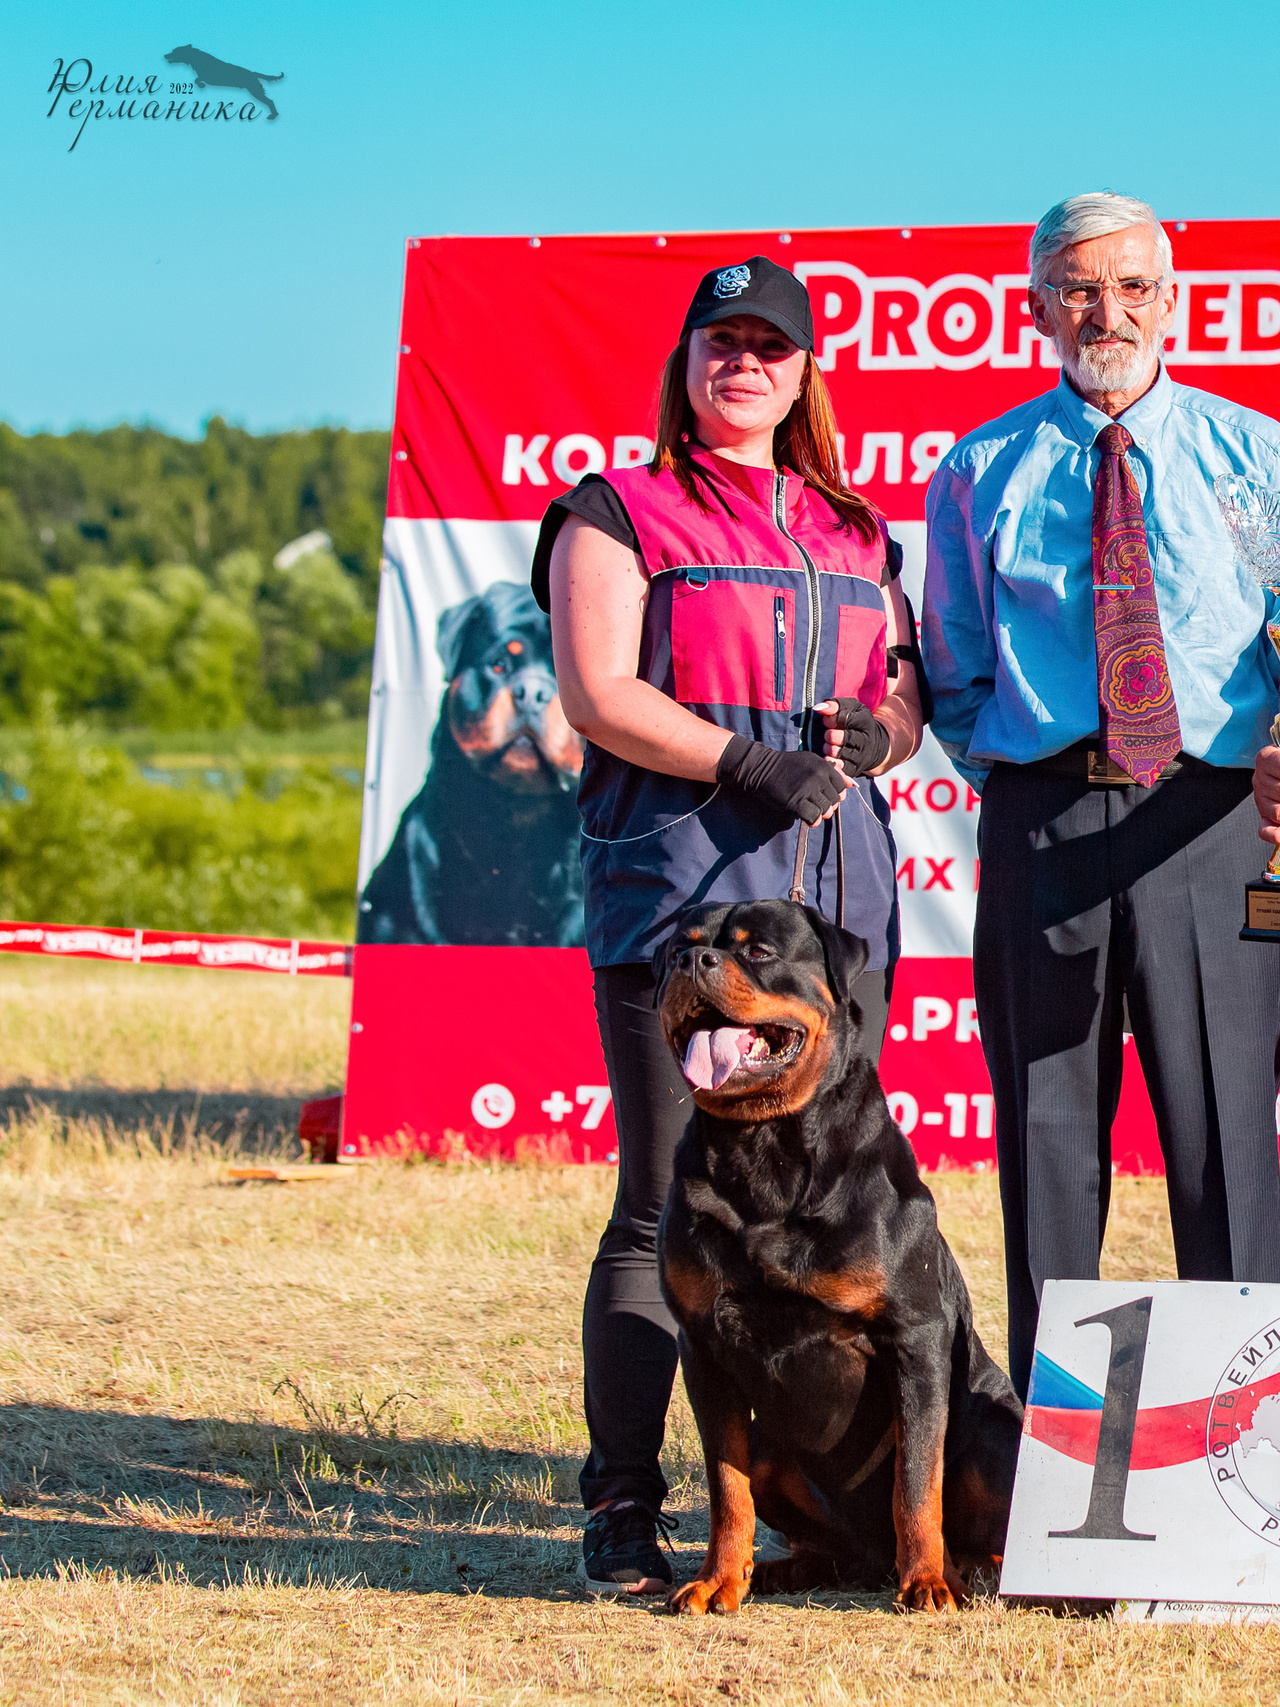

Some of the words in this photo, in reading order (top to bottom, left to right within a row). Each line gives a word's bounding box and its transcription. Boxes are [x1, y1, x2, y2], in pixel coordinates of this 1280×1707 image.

[836, 431, 955, 486] ЛЯ
[897, 856, 954, 892] ИХ
[1048, 1295, 1156, 1542] 1
[1163, 1601, 1204, 1613] Корма
